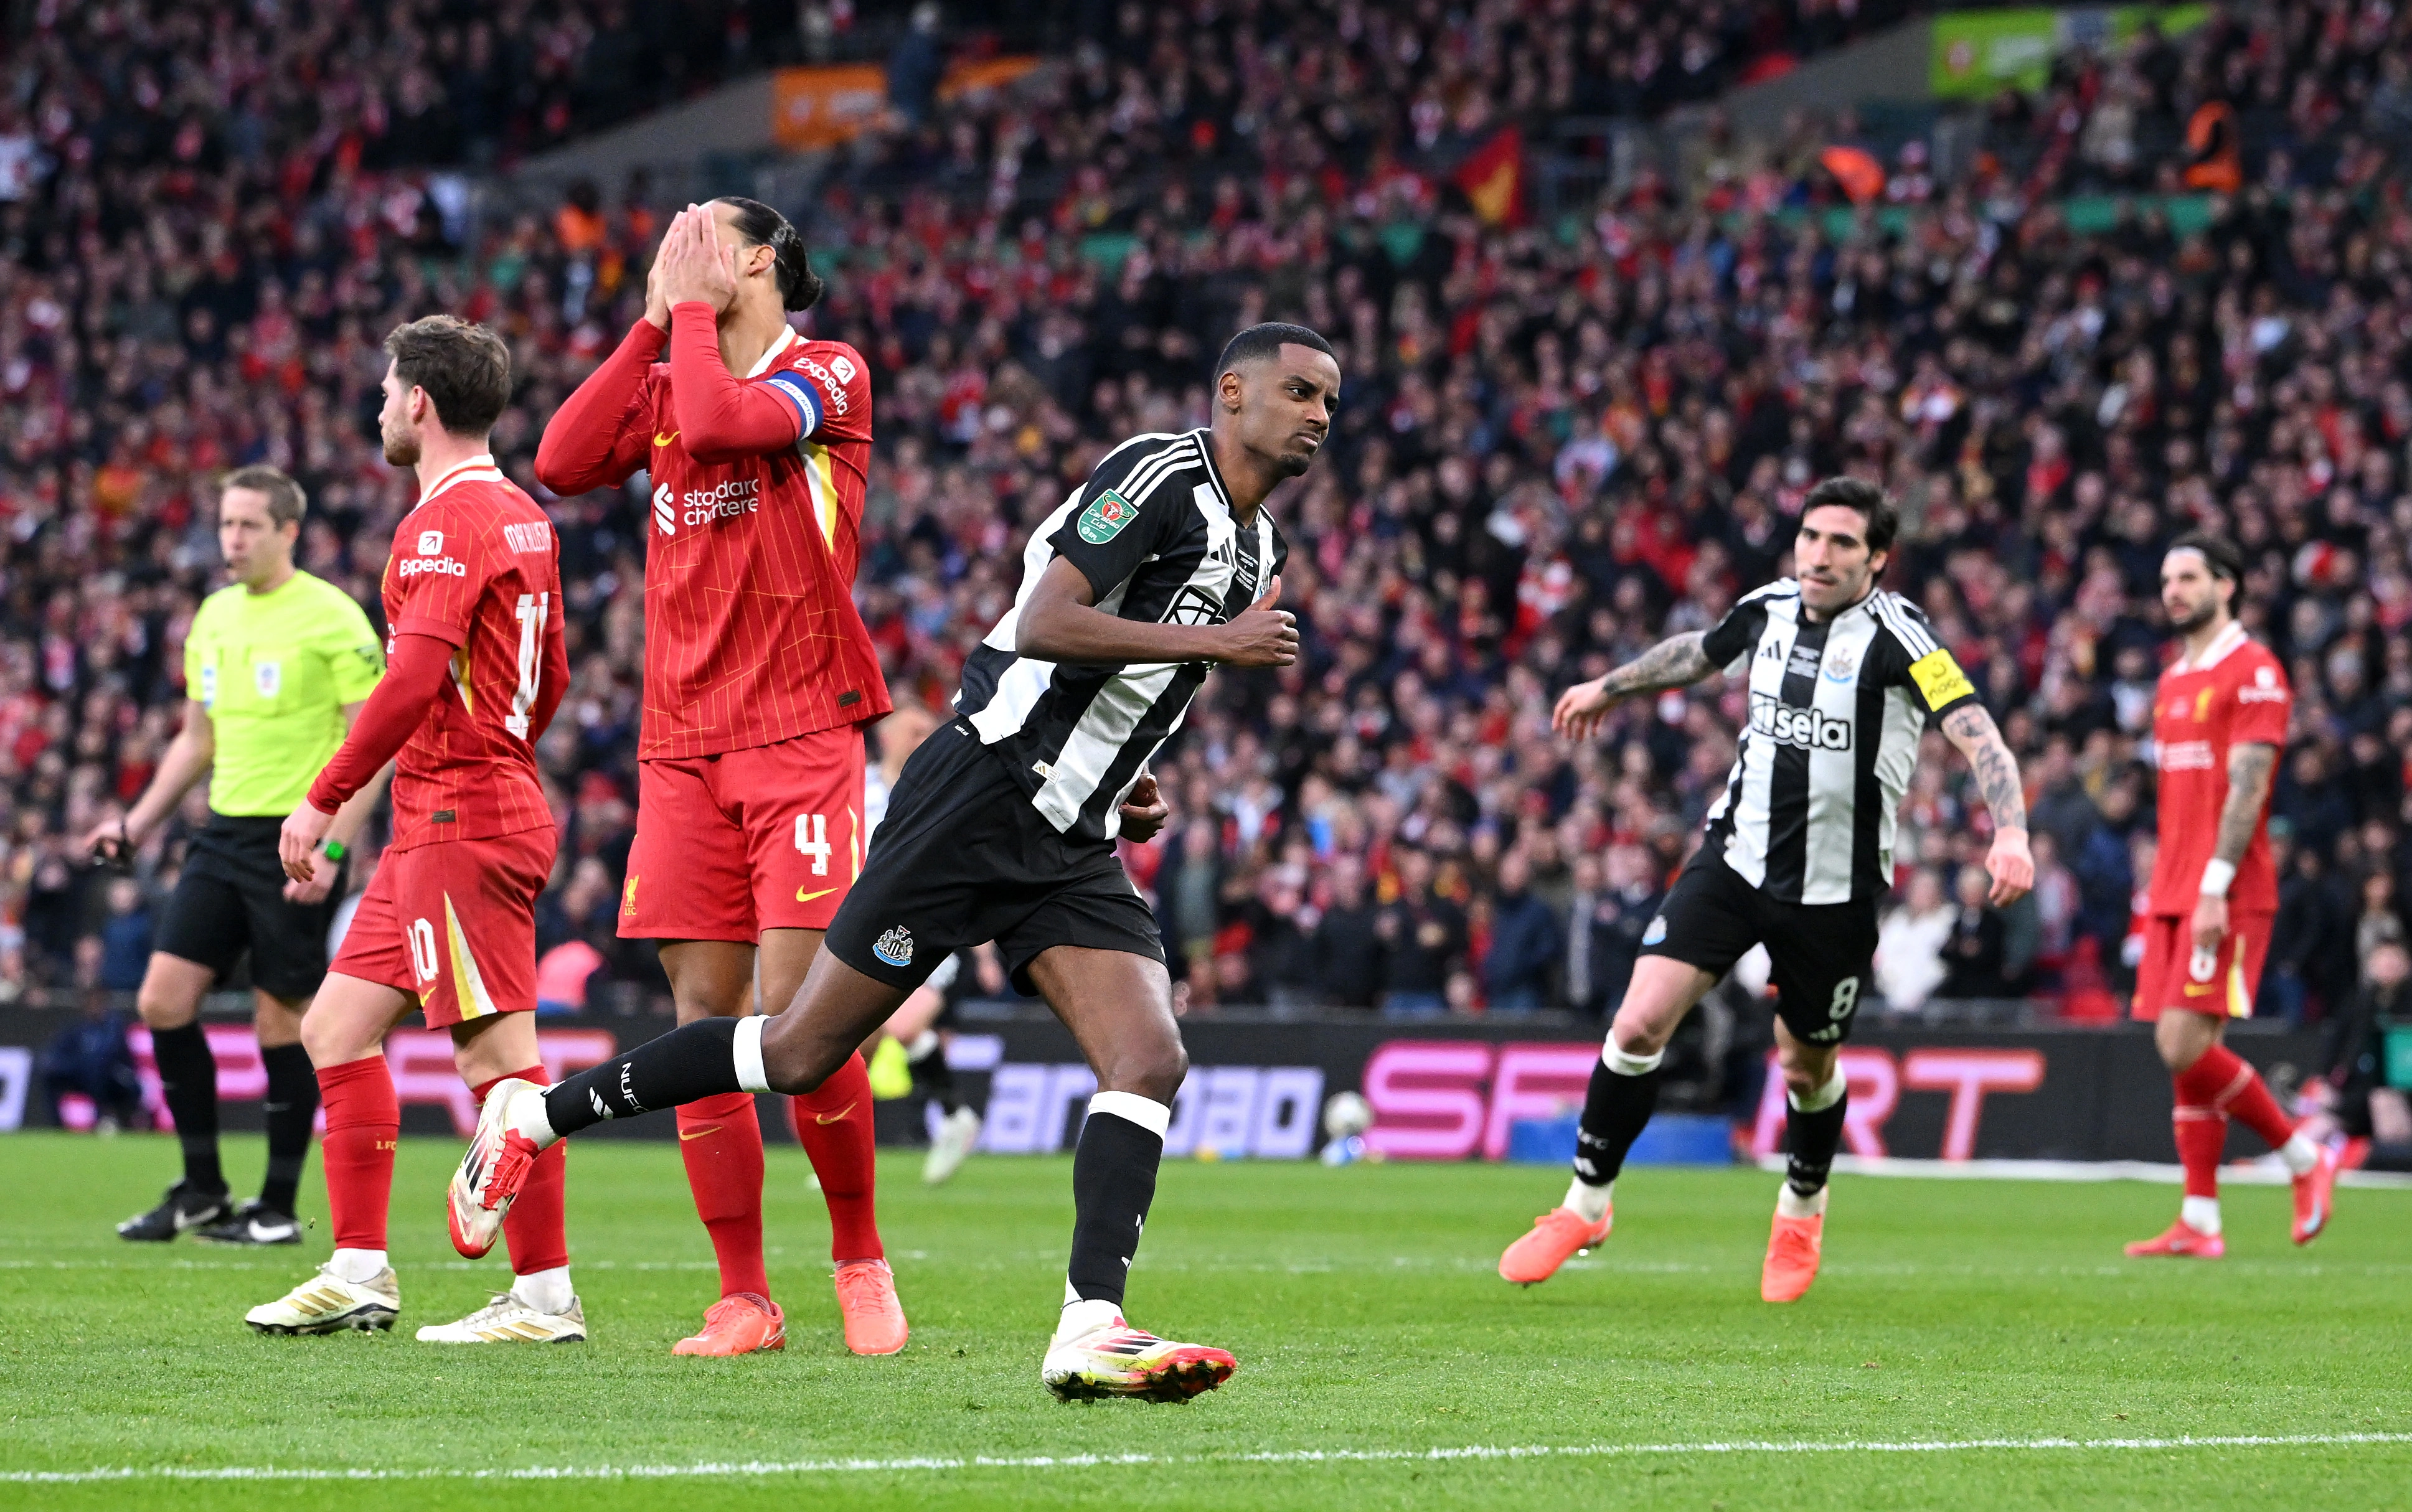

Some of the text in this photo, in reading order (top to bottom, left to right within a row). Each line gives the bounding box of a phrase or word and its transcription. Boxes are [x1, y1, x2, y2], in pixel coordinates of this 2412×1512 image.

[793, 357, 848, 416] Expedia
[684, 479, 759, 507] stadar
[684, 497, 759, 525] chrtere
[1088, 509, 1120, 529] Carabao
[1090, 518, 1106, 530] Cup
[399, 556, 466, 577] Expedia
[1774, 708, 1850, 750] sela
[794, 814, 832, 876] 4
[624, 907, 637, 916] LFC
[1829, 976, 1859, 1020] 8
[621, 1062, 649, 1112] NUFC
[1362, 1041, 2047, 1163] SPRT
